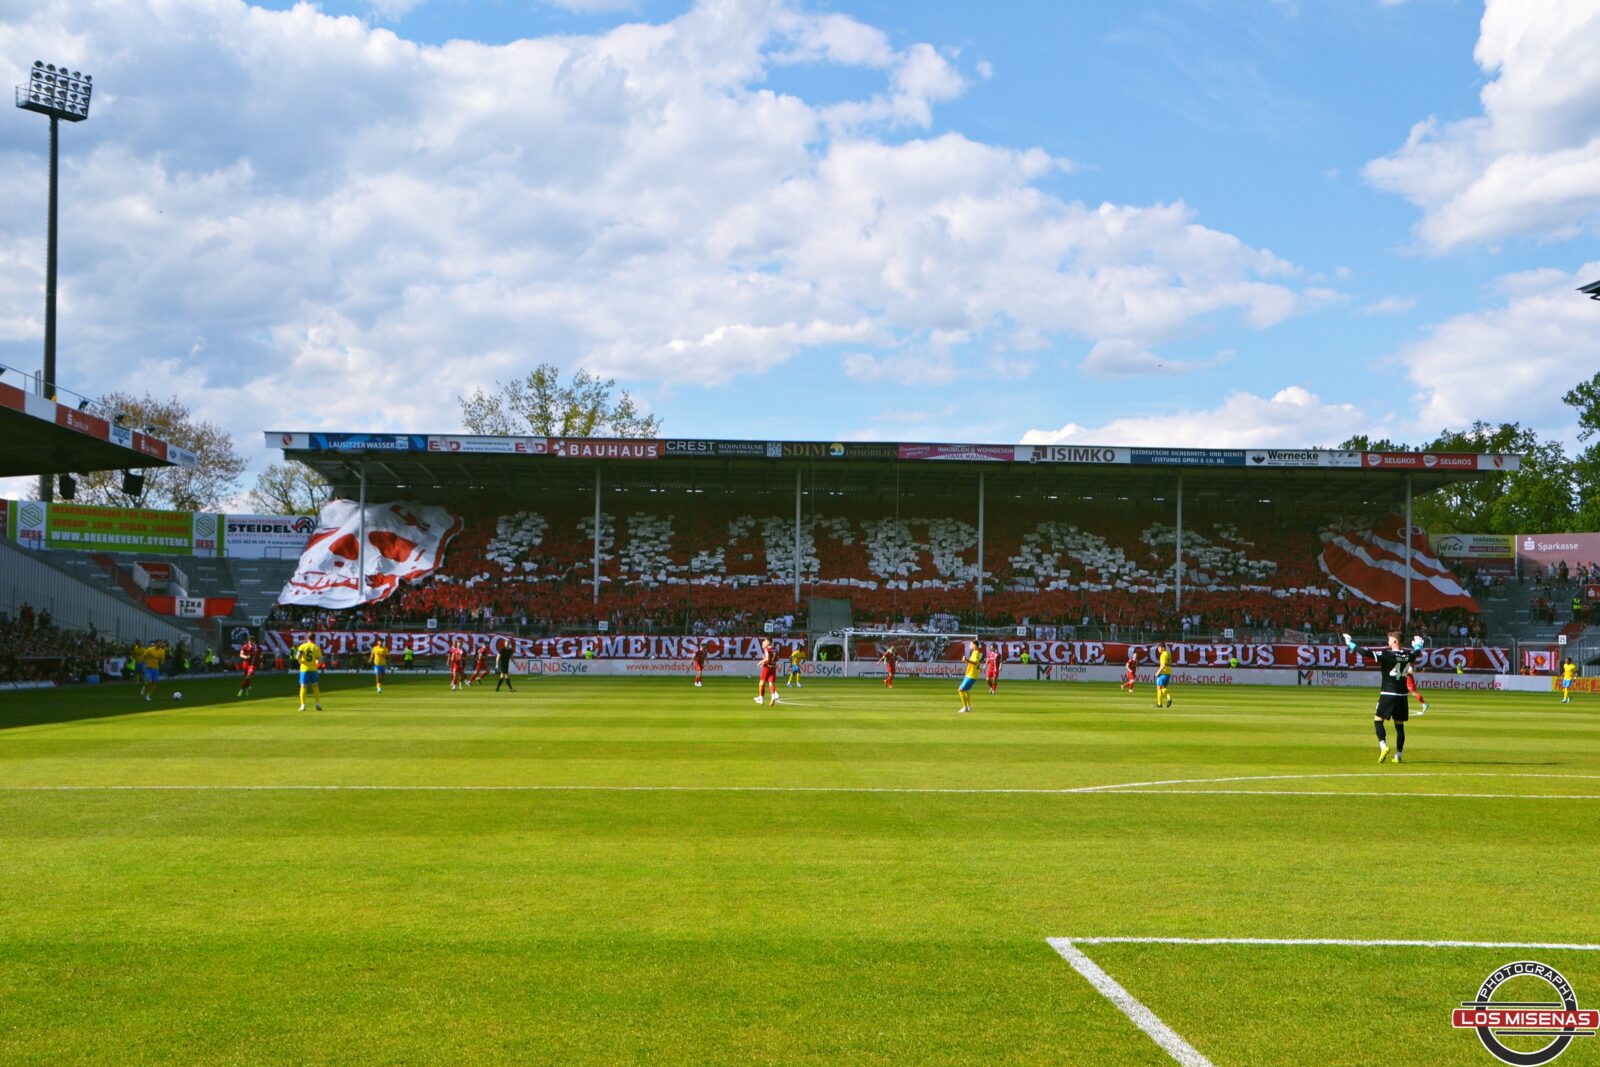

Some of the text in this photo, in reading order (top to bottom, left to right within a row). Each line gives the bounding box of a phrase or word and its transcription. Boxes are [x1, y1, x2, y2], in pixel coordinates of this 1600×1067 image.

[328, 441, 366, 449] LAUSITZER
[366, 441, 395, 449] WASSER
[666, 441, 716, 451] CREST
[783, 443, 826, 457] SDIM
[569, 444, 657, 457] BAUHAUS
[1051, 448, 1116, 462] ISIMKO
[1267, 451, 1319, 460] Wernecke
[1383, 457, 1416, 465] SELGROS
[1439, 458, 1472, 466] SELGROS
[227, 523, 292, 534] STEIDEL
[1537, 542, 1579, 551] Sparkasse
[306, 650, 314, 662] 5
[1127, 643, 1275, 666] COTTBUS
[515, 660, 588, 674] WANDStyle
[1321, 671, 1348, 679] Mende
